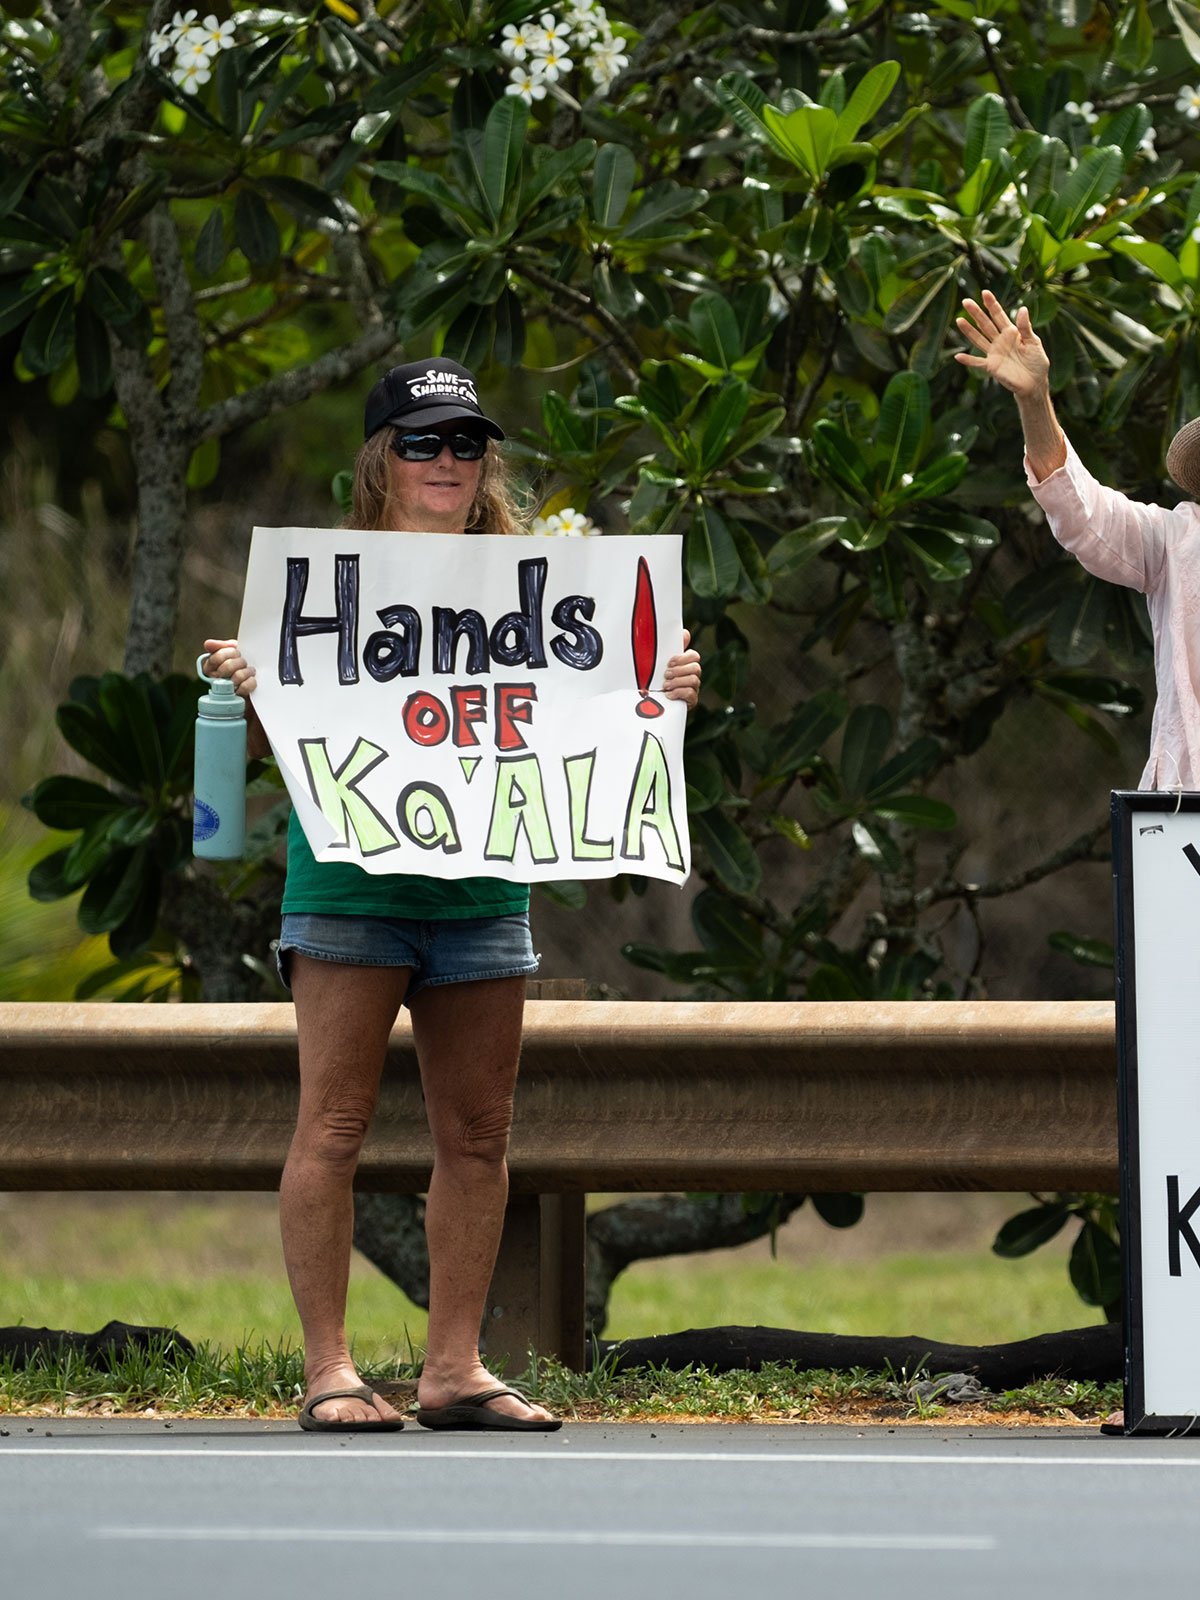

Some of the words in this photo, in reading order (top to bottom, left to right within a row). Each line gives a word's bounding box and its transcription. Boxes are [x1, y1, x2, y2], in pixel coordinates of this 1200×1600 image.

[426, 369, 458, 384] SAVE
[279, 554, 603, 686] Hands
[401, 682, 538, 751] OFF
